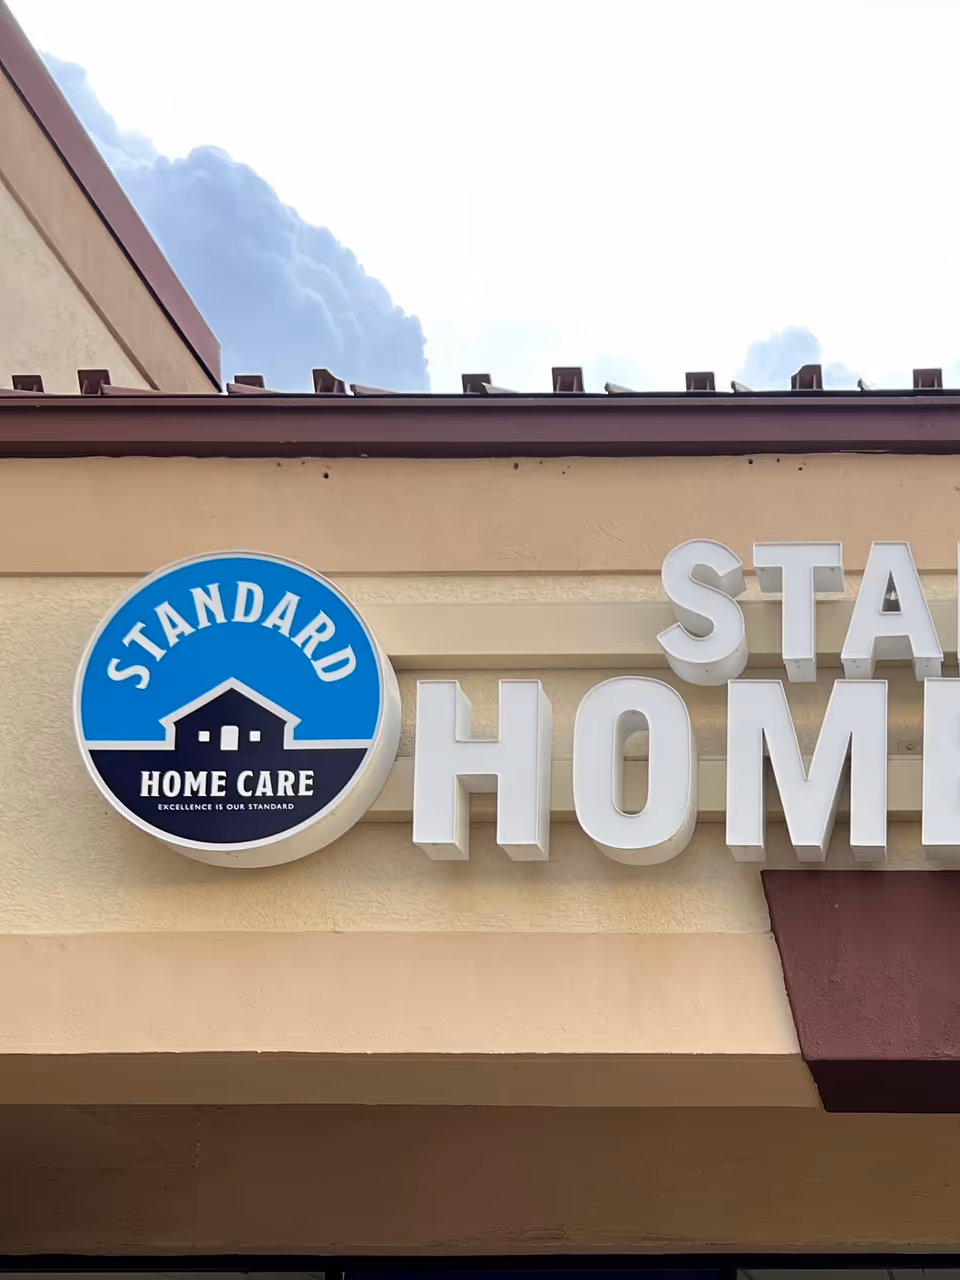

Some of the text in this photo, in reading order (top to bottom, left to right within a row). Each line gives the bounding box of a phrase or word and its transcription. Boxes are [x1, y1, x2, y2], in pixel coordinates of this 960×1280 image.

[107, 581, 356, 689] STANDARD
[140, 769, 315, 797] HOME CARE
